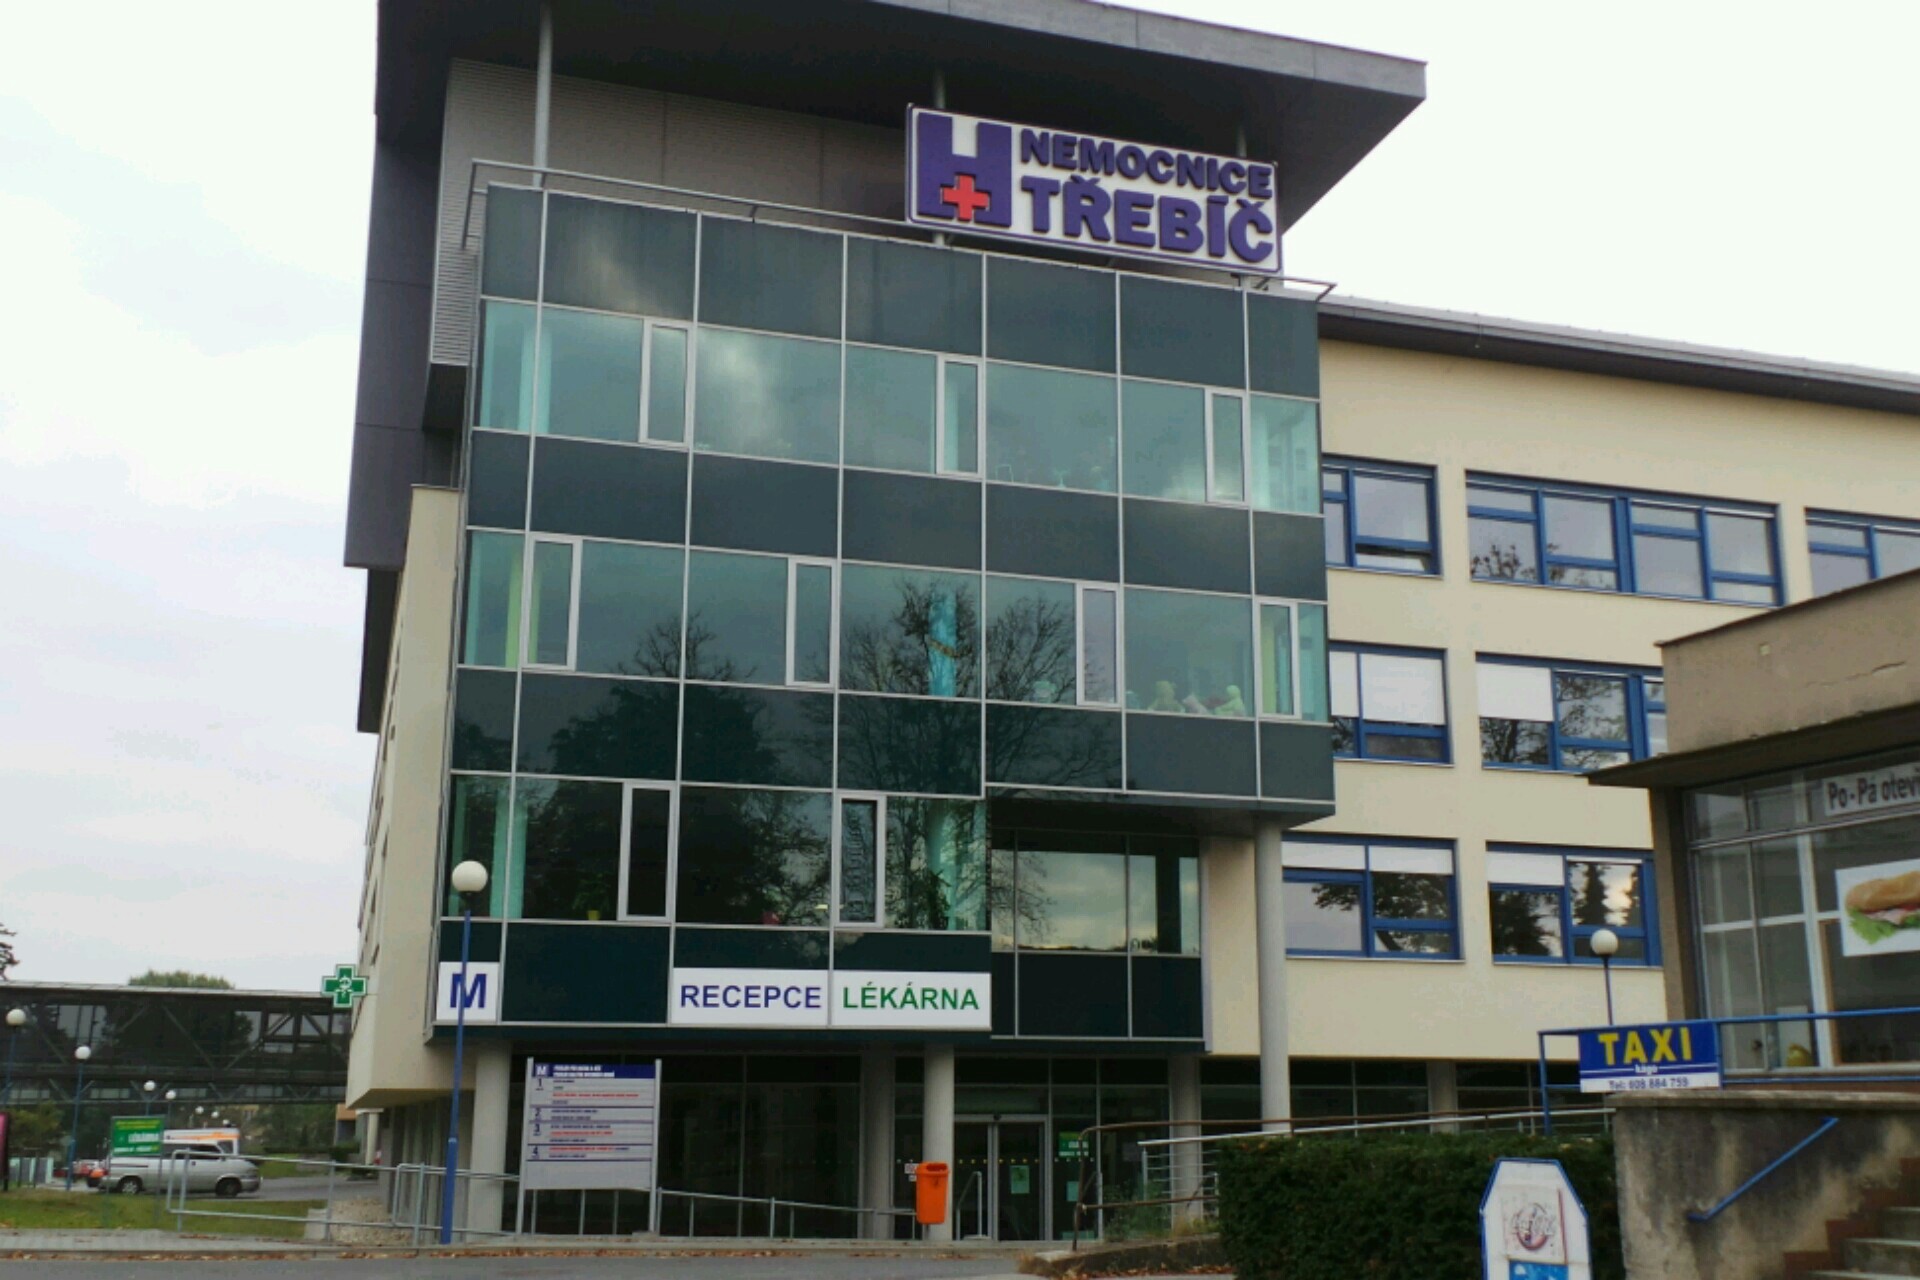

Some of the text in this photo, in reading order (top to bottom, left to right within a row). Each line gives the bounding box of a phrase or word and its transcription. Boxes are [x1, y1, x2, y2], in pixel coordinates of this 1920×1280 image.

[1020, 128, 1273, 199] NEMOCNICE
[1021, 174, 1274, 263] TŘEBÍČ
[448, 973, 488, 1009] M
[681, 984, 821, 1010] RECEPCE
[842, 980, 979, 1011] LÉKÁRNA
[1597, 1026, 1692, 1066] TAXI
